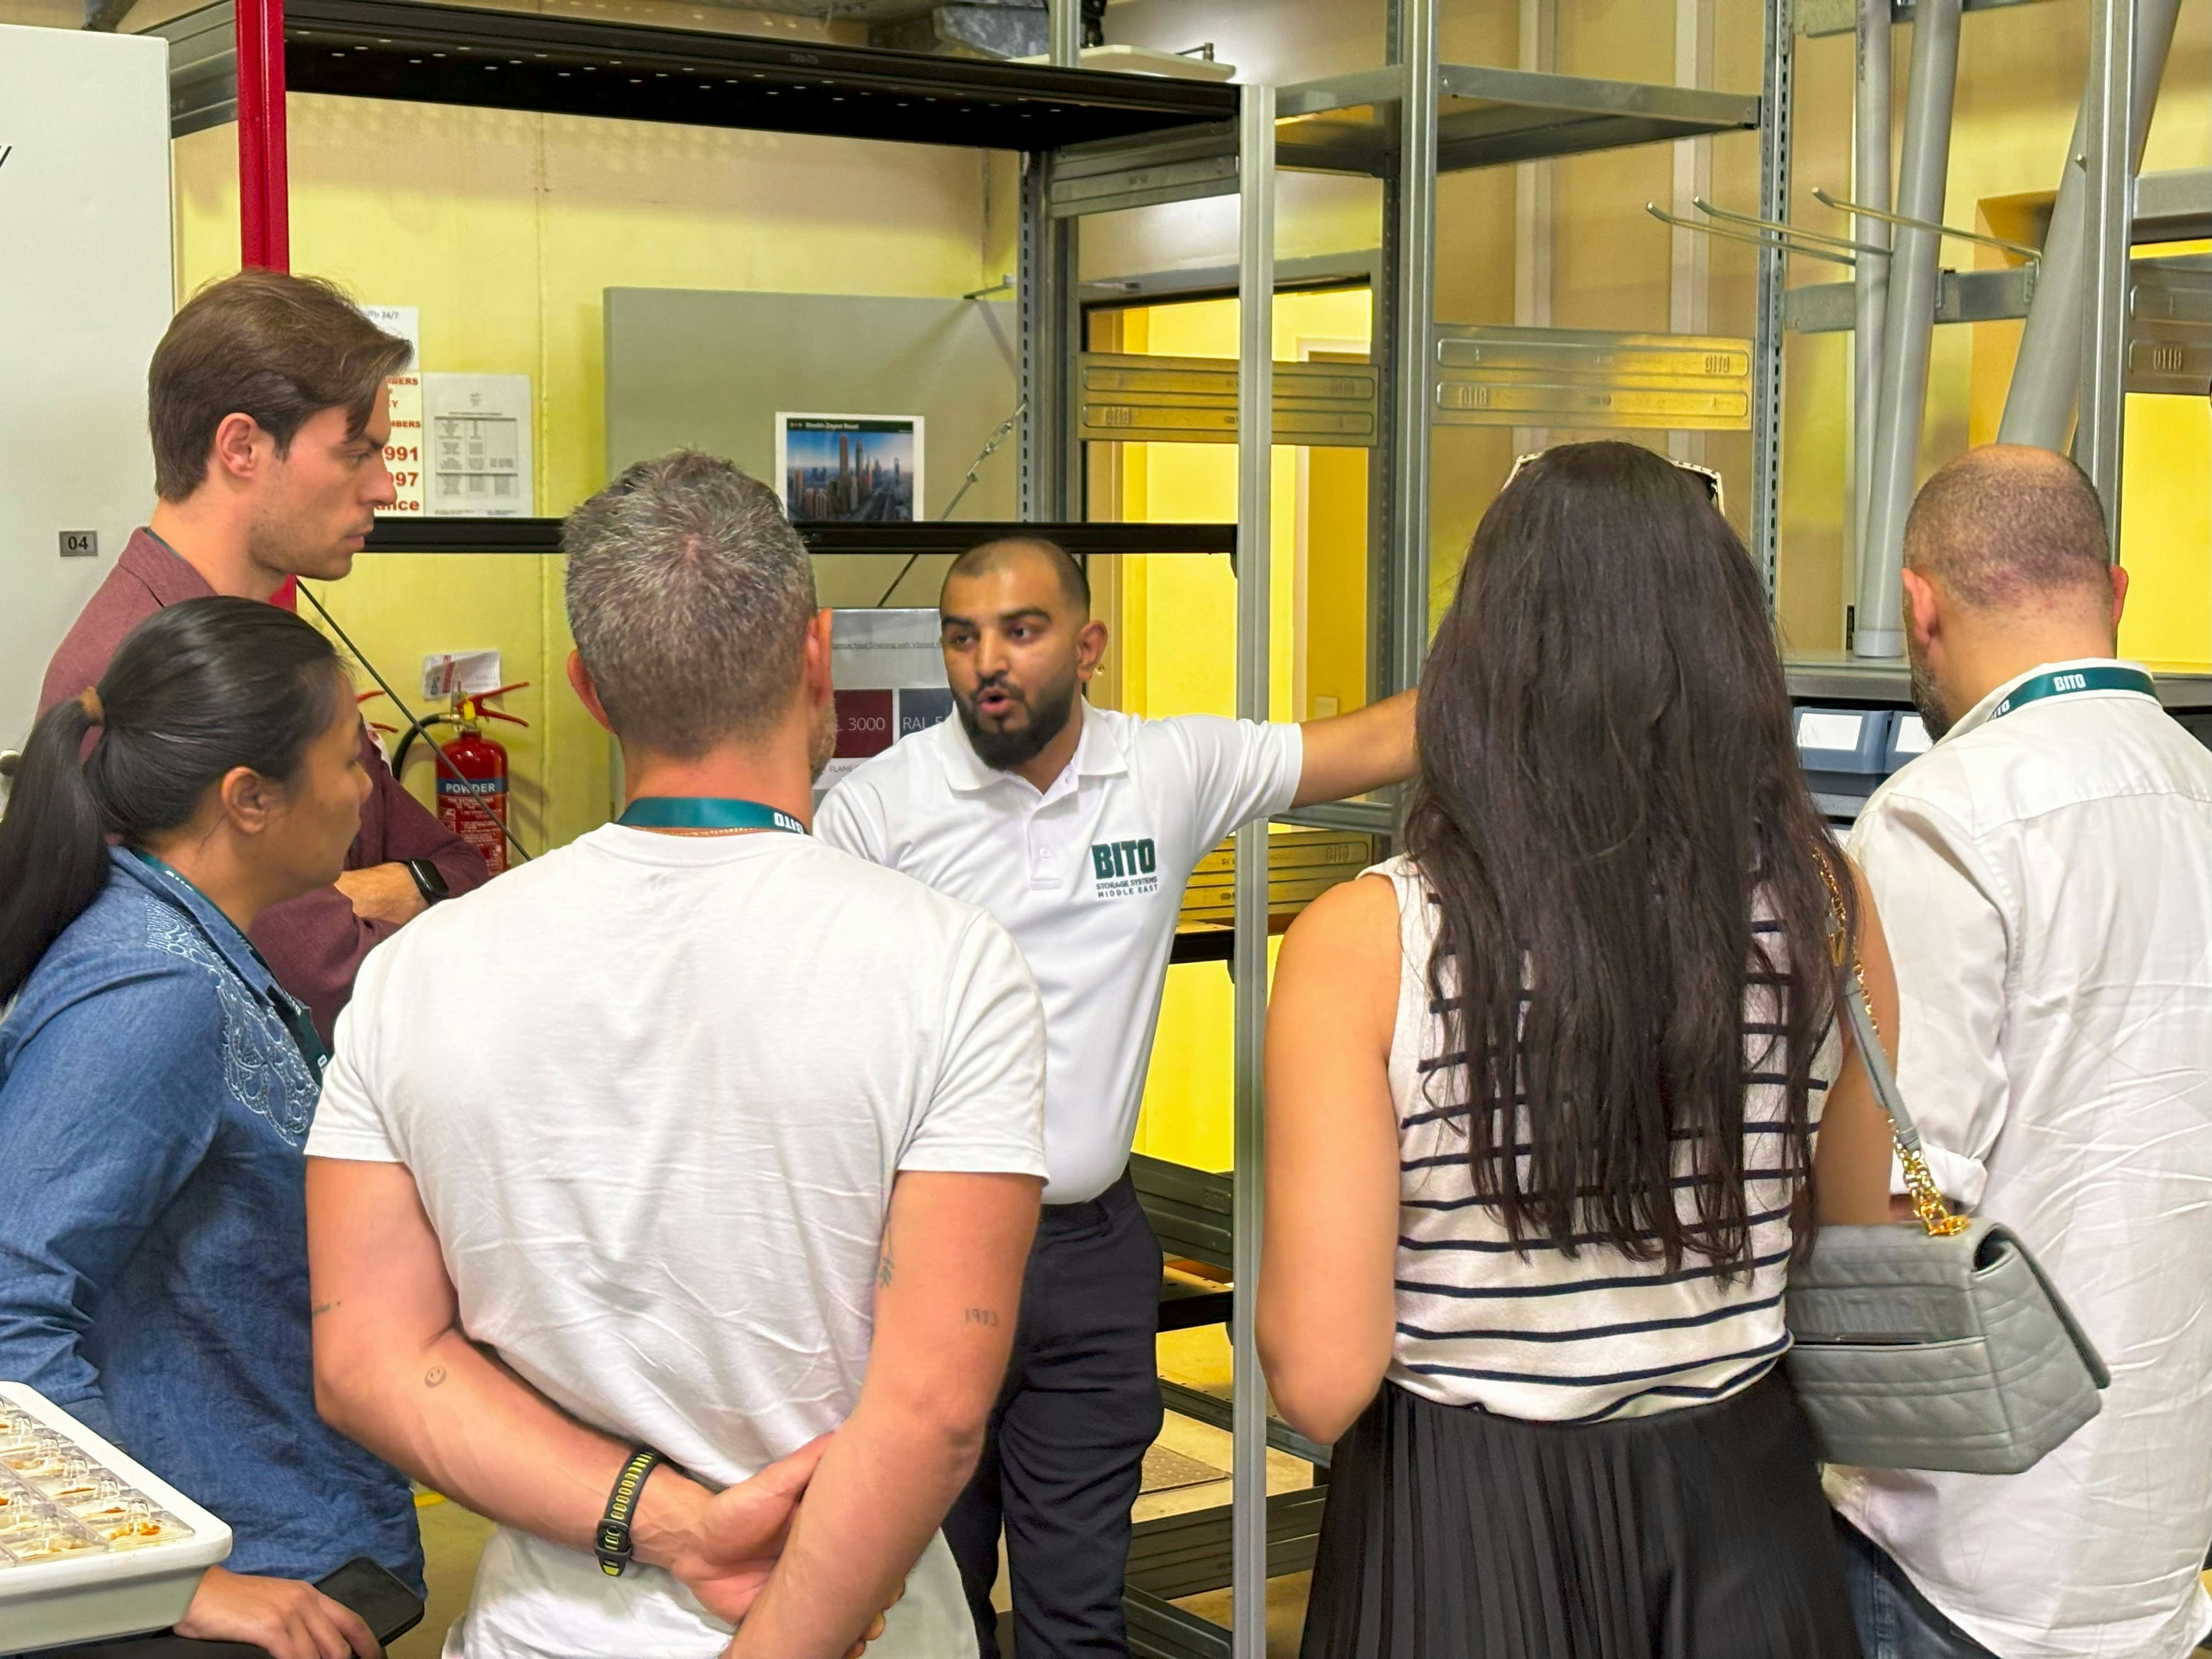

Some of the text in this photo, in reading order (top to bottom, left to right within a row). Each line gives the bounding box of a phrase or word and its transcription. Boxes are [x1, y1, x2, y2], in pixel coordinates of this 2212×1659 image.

[68, 535, 89, 550] 04
[2053, 673, 2086, 691] BITO
[848, 716, 885, 731] 3000
[902, 716, 926, 730] RAL
[1091, 838, 1156, 879] BITO
[1096, 876, 1157, 890] STORAGE SYSTEMS
[1098, 884, 1158, 898] MIDDLE EAST
